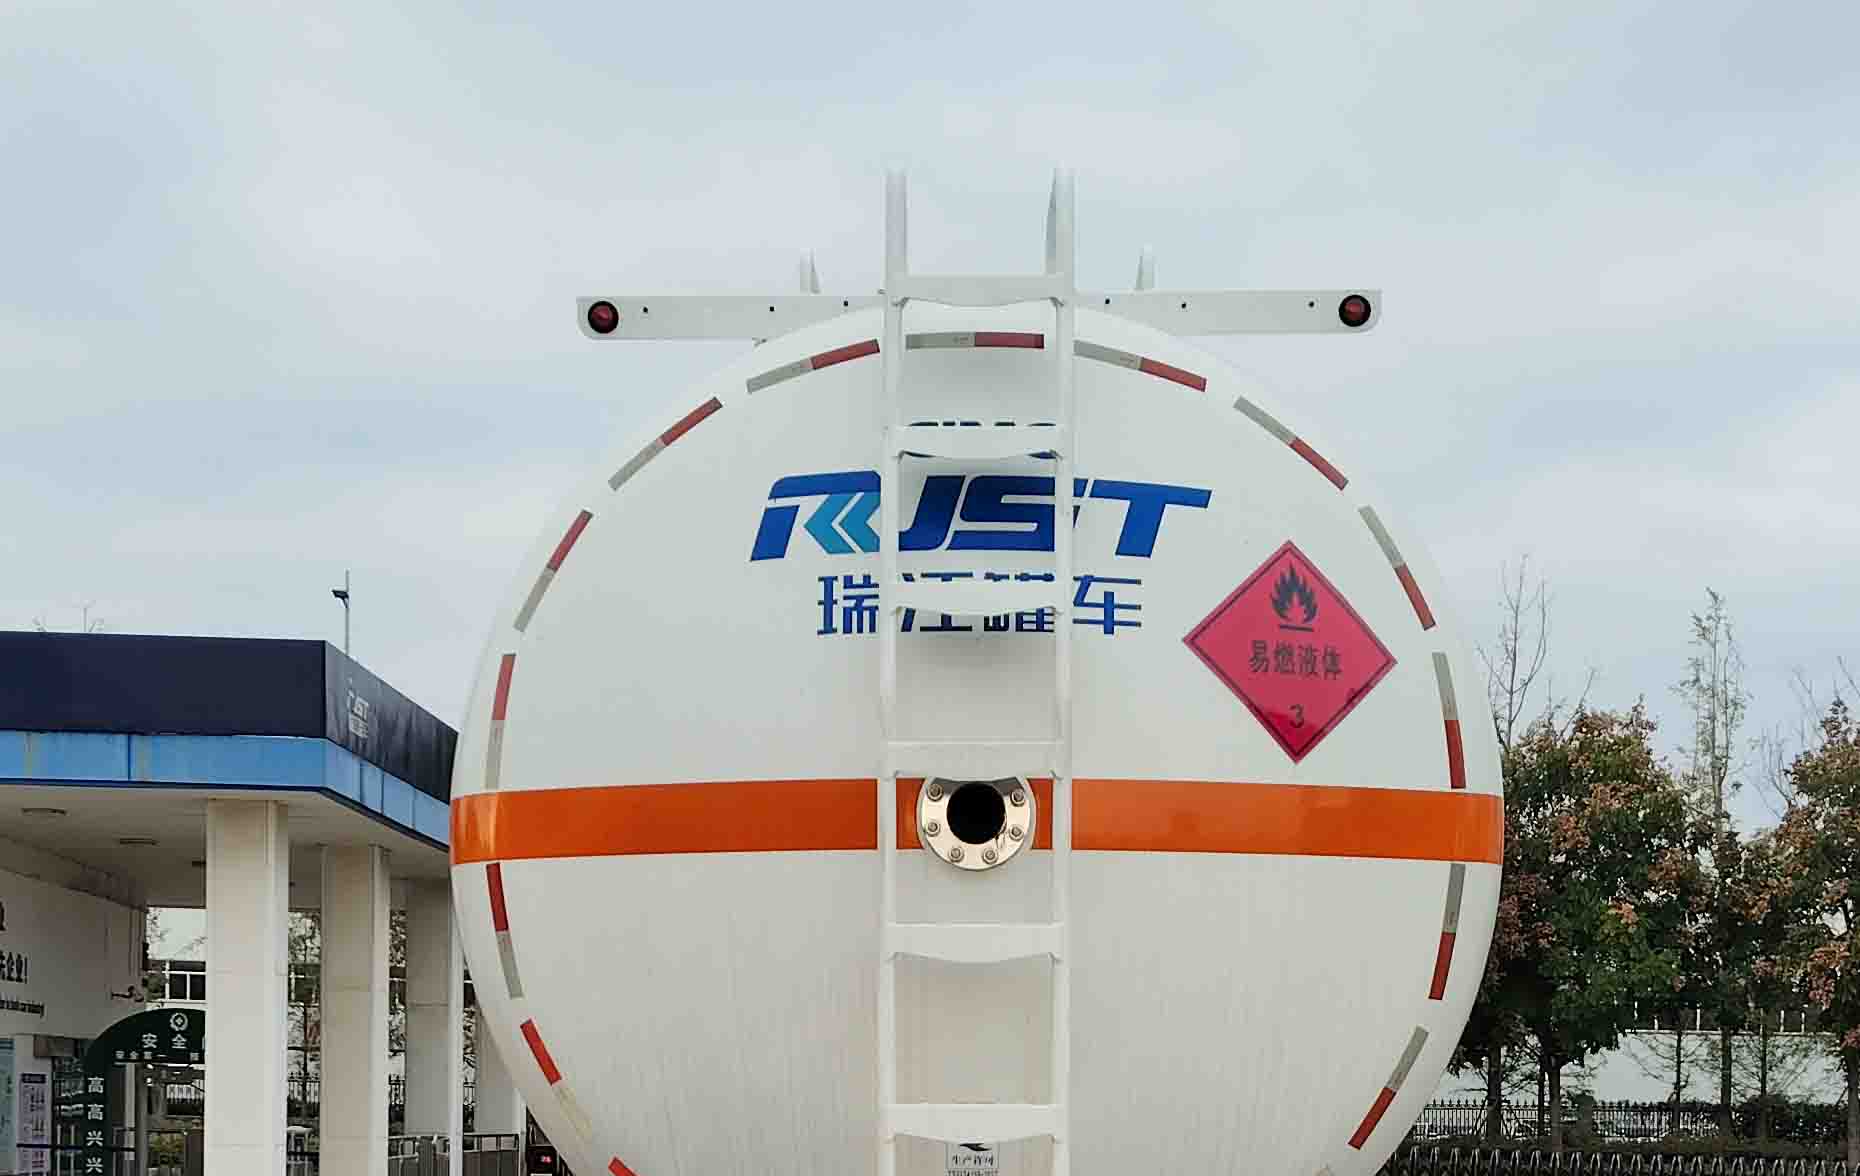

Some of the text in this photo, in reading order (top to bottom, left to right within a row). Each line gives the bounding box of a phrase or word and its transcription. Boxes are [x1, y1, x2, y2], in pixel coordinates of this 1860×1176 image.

[1250, 640, 1343, 680] 易燃液体
[1289, 704, 1305, 729] 3
